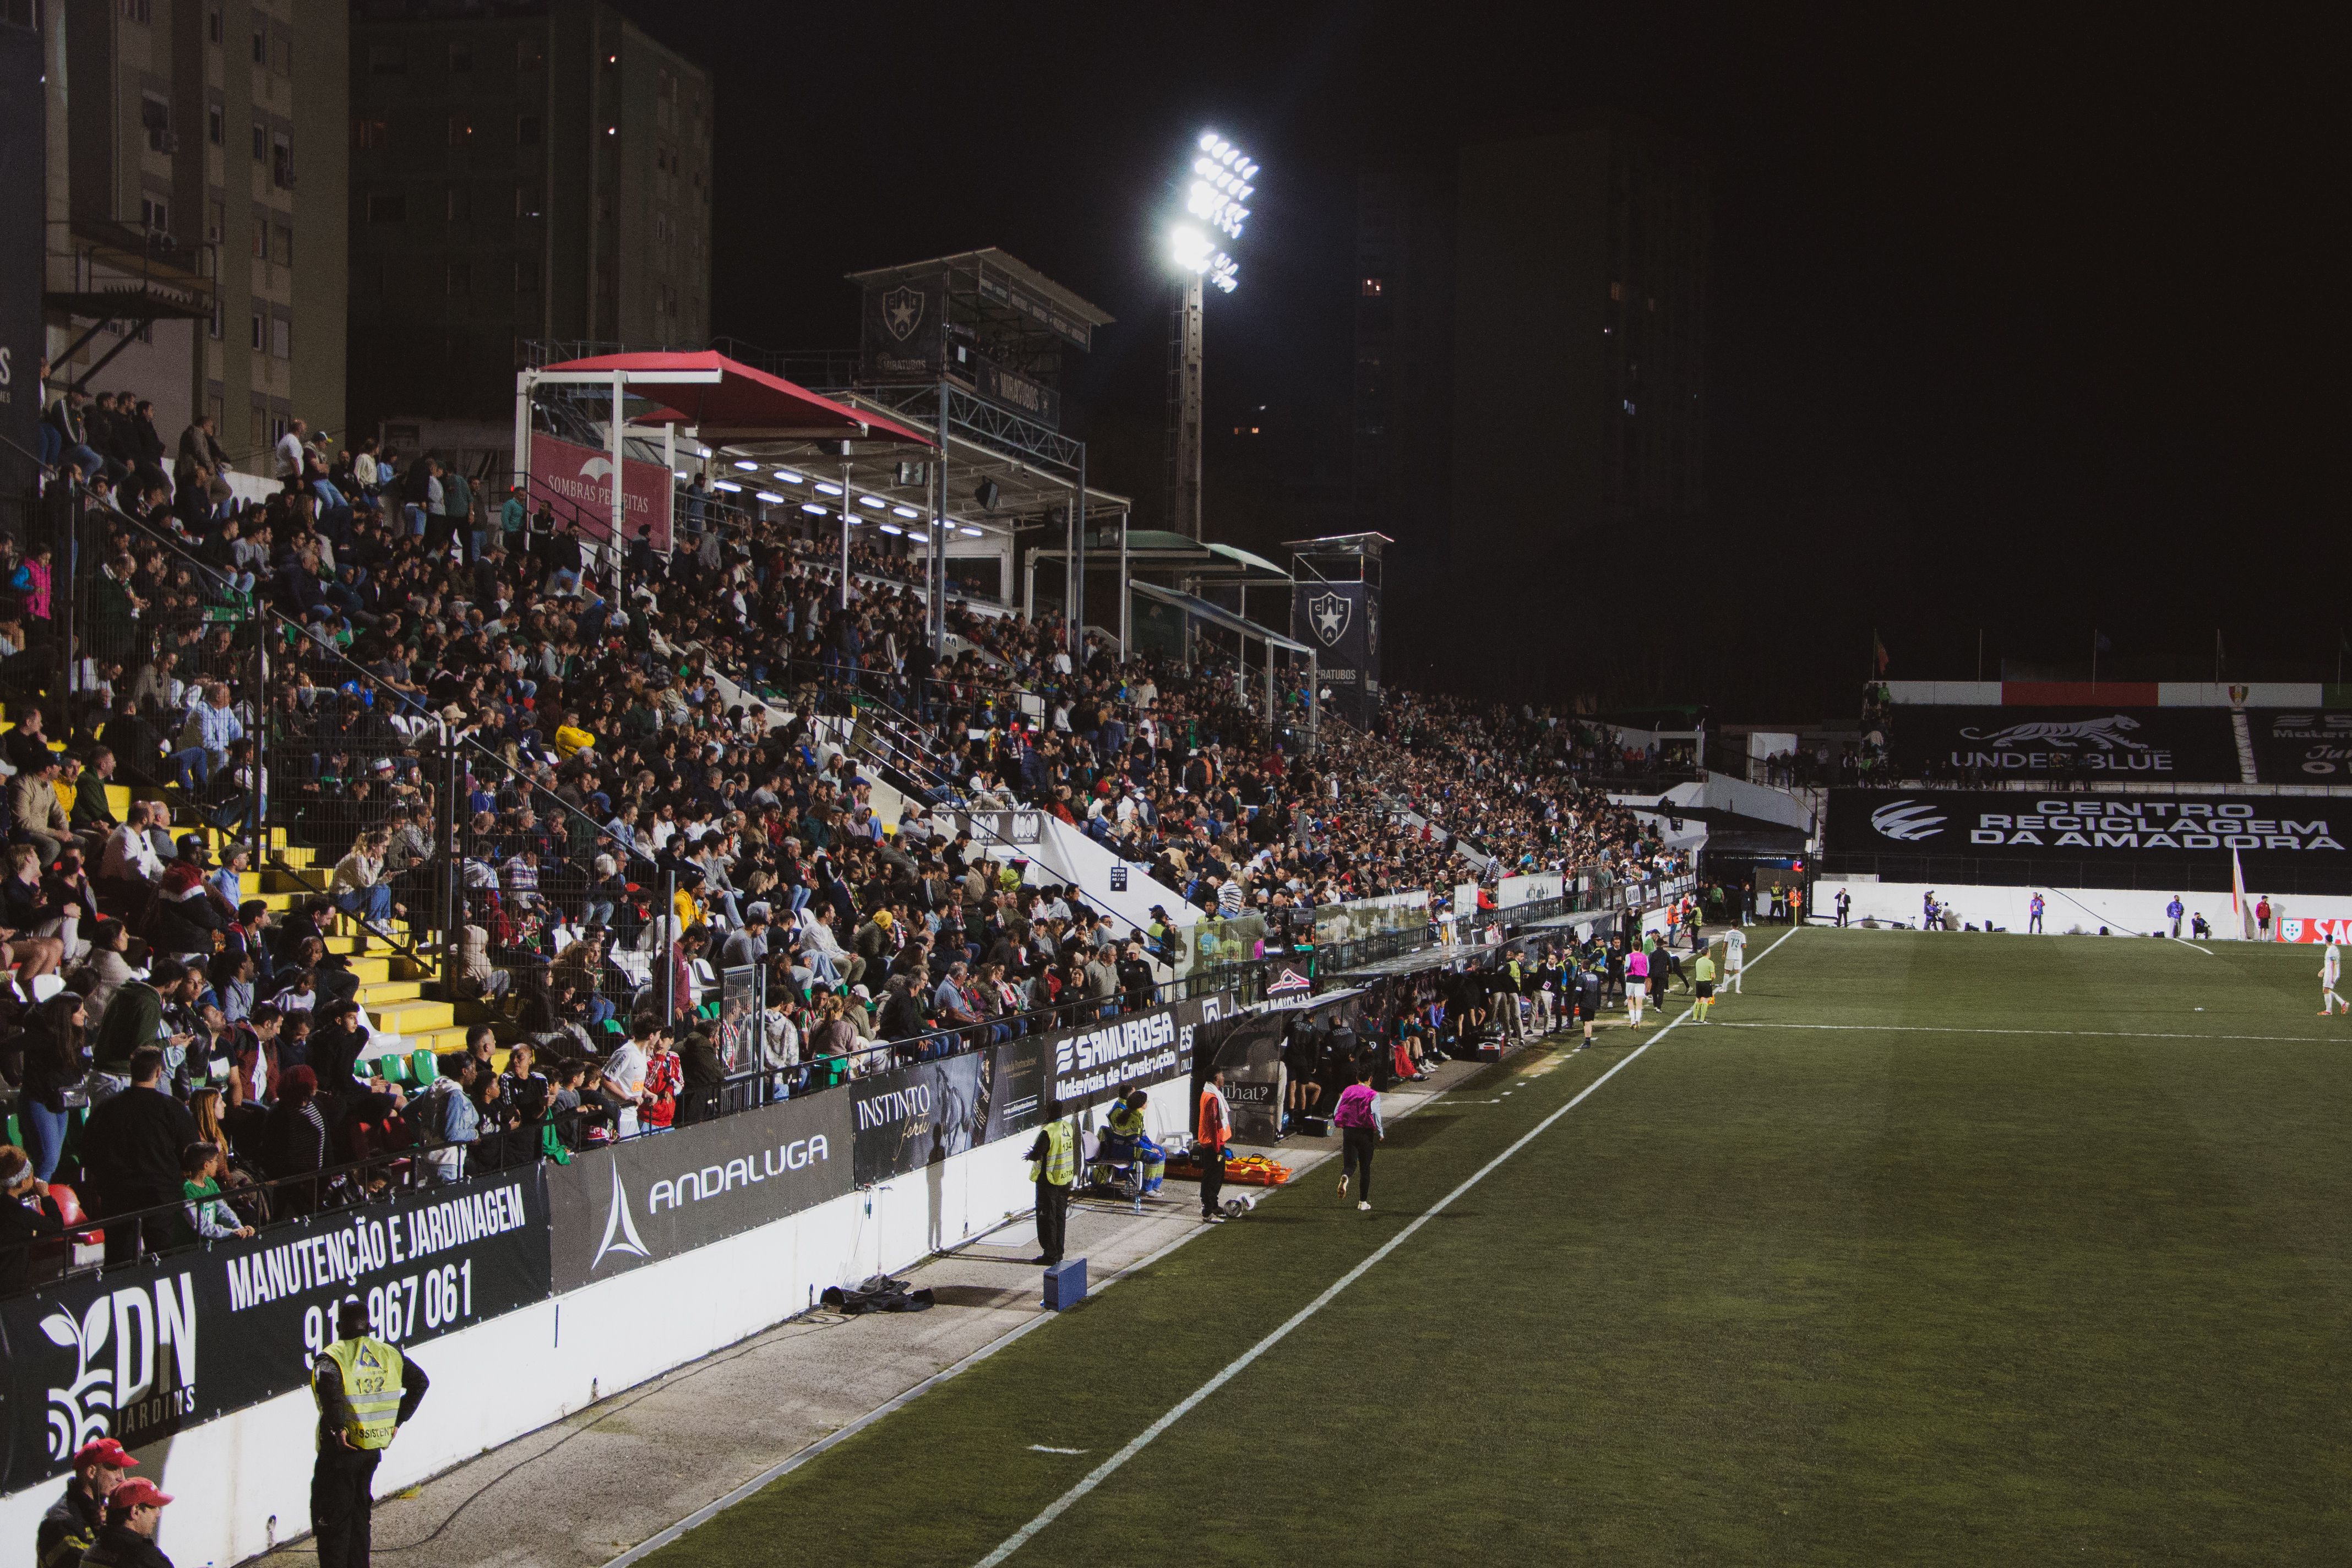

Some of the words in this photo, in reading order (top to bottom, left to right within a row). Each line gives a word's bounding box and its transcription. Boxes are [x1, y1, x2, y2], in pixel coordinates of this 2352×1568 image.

[548, 475, 596, 502] SOMBRAS
[598, 487, 649, 513] PEEITAS
[1315, 669, 1356, 680] RATUBOS
[1980, 814, 2328, 835] RECICLAGEM
[2037, 801, 2253, 818] CENTRO
[1971, 830, 2044, 846] DA
[2054, 832, 2346, 850] AMADORA
[1076, 1011, 1174, 1070] SAMUROSA
[1180, 1023, 1196, 1052] ES
[1056, 1071, 1105, 1101] Materiais
[1107, 1066, 1120, 1086] de
[1121, 1048, 1175, 1080] Construção
[857, 1084, 930, 1130] INSTINTO
[1063, 1141, 1072, 1152] 134
[649, 1135, 828, 1215] ANDALUGA
[227, 1216, 386, 1311] MANUTENÇÃO
[388, 1215, 405, 1264] E
[409, 1183, 526, 1259] JARDINAGEM
[304, 1294, 360, 1370] 91
[368, 1275, 418, 1343] 967
[425, 1259, 472, 1329] 061
[112, 1272, 197, 1409] DN
[356, 1376, 385, 1394] 132
[115, 1386, 195, 1438] JARDINS
